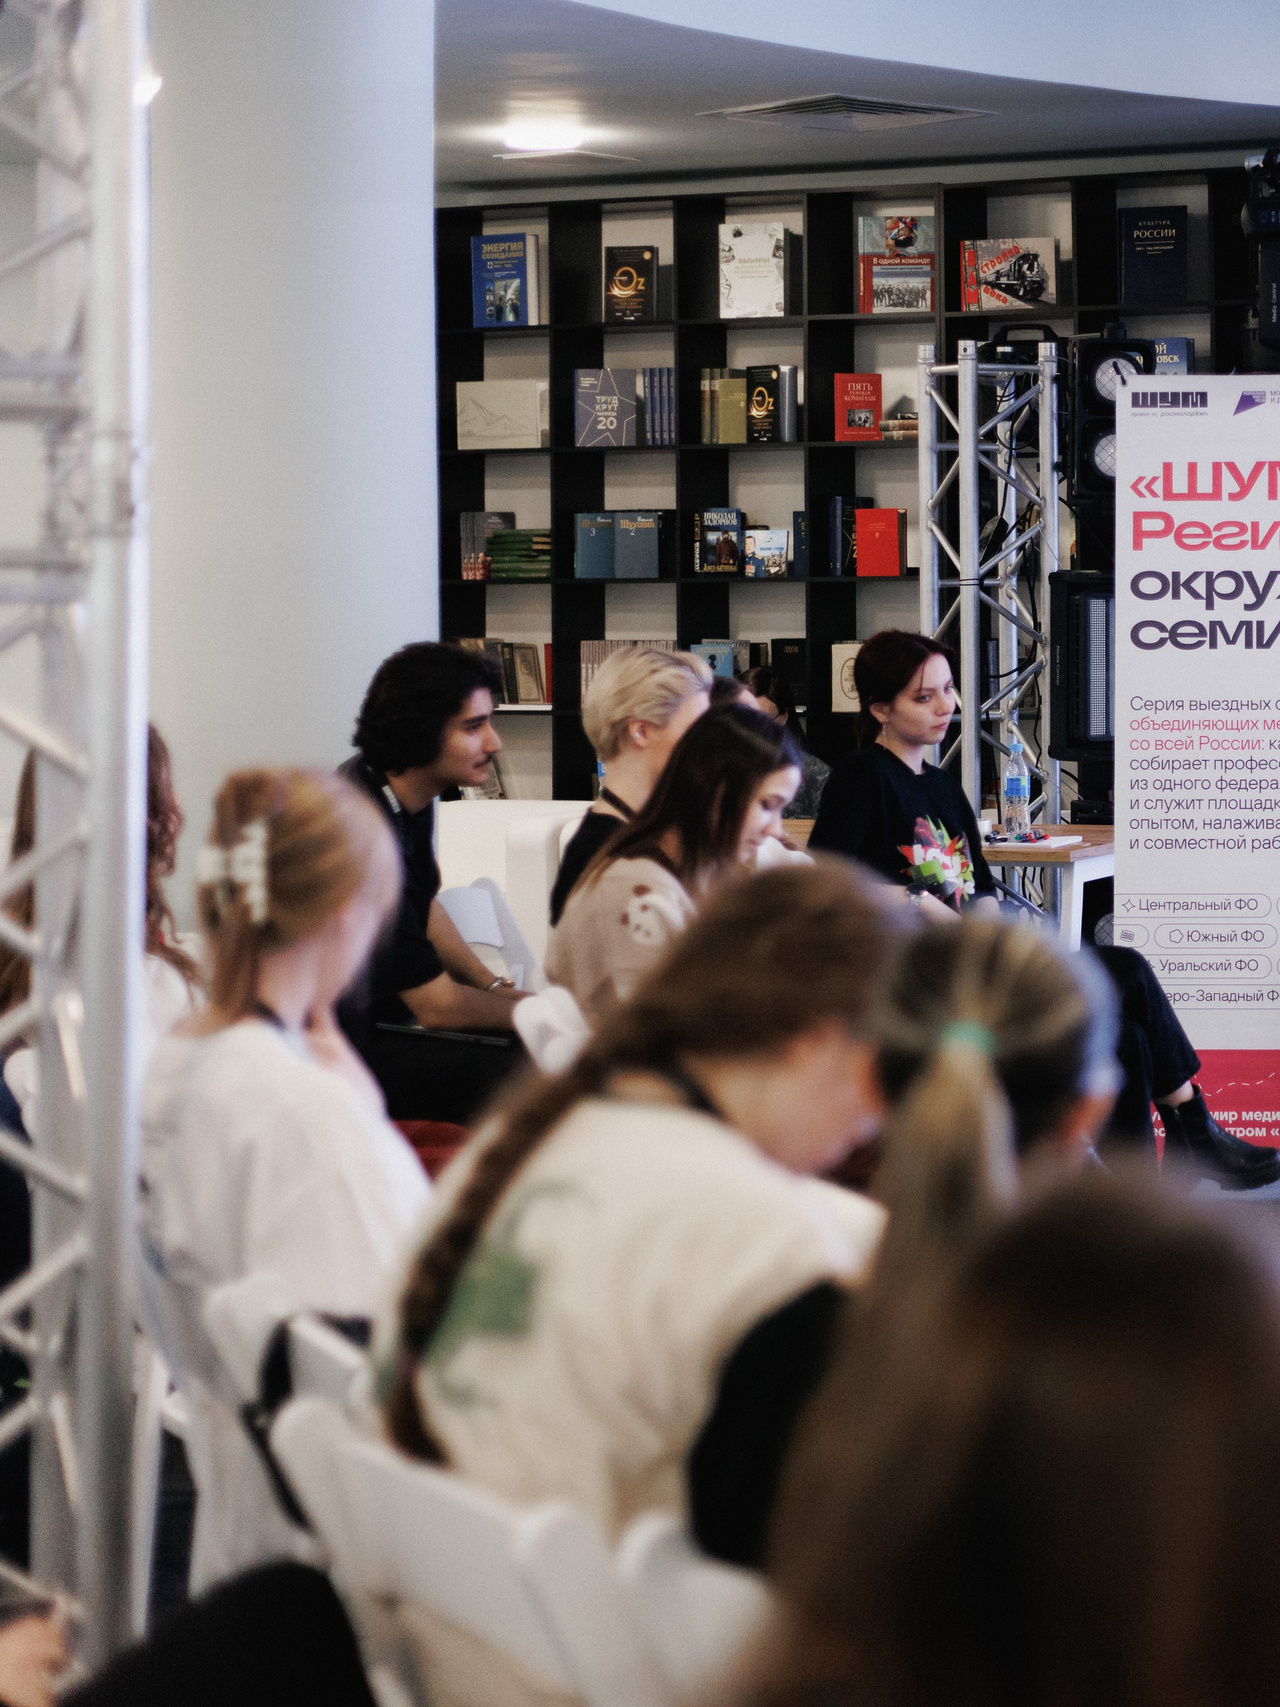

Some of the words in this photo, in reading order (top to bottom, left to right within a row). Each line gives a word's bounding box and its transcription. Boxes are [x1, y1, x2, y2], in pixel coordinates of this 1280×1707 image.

[1133, 229, 1176, 238] РОССИИ
[901, 258, 931, 266] команде
[847, 382, 874, 391] ПЯТЬ
[595, 395, 619, 405] ТРУД
[595, 404, 619, 412] КРУТ
[596, 416, 618, 430] 20
[590, 527, 596, 537] 3
[1130, 695, 1185, 714] Серия
[1190, 699, 1272, 712] выездных
[1130, 715, 1260, 732] объединяющих
[1130, 739, 1151, 750] со
[1155, 735, 1195, 750] всей
[1199, 735, 1265, 750] России:
[1130, 754, 1211, 773] собирает
[1130, 778, 1149, 790] из
[1153, 778, 1212, 792] одного
[1130, 798, 1140, 809] и
[1144, 798, 1205, 813] служит
[1130, 818, 1198, 831] опытом,
[1130, 838, 1140, 849] и
[1144, 834, 1247, 849] совместной
[1139, 898, 1232, 913] Центральный
[1235, 897, 1259, 910] ФО
[1187, 929, 1238, 942] Южный
[1241, 929, 1265, 942] ФО
[1160, 958, 1232, 974] Уральский
[1235, 958, 1259, 971] ФО
[1166, 989, 1264, 1004] еро-Западный
[1209, 1111, 1238, 1124] мир
[1225, 1127, 1267, 1138] тром
